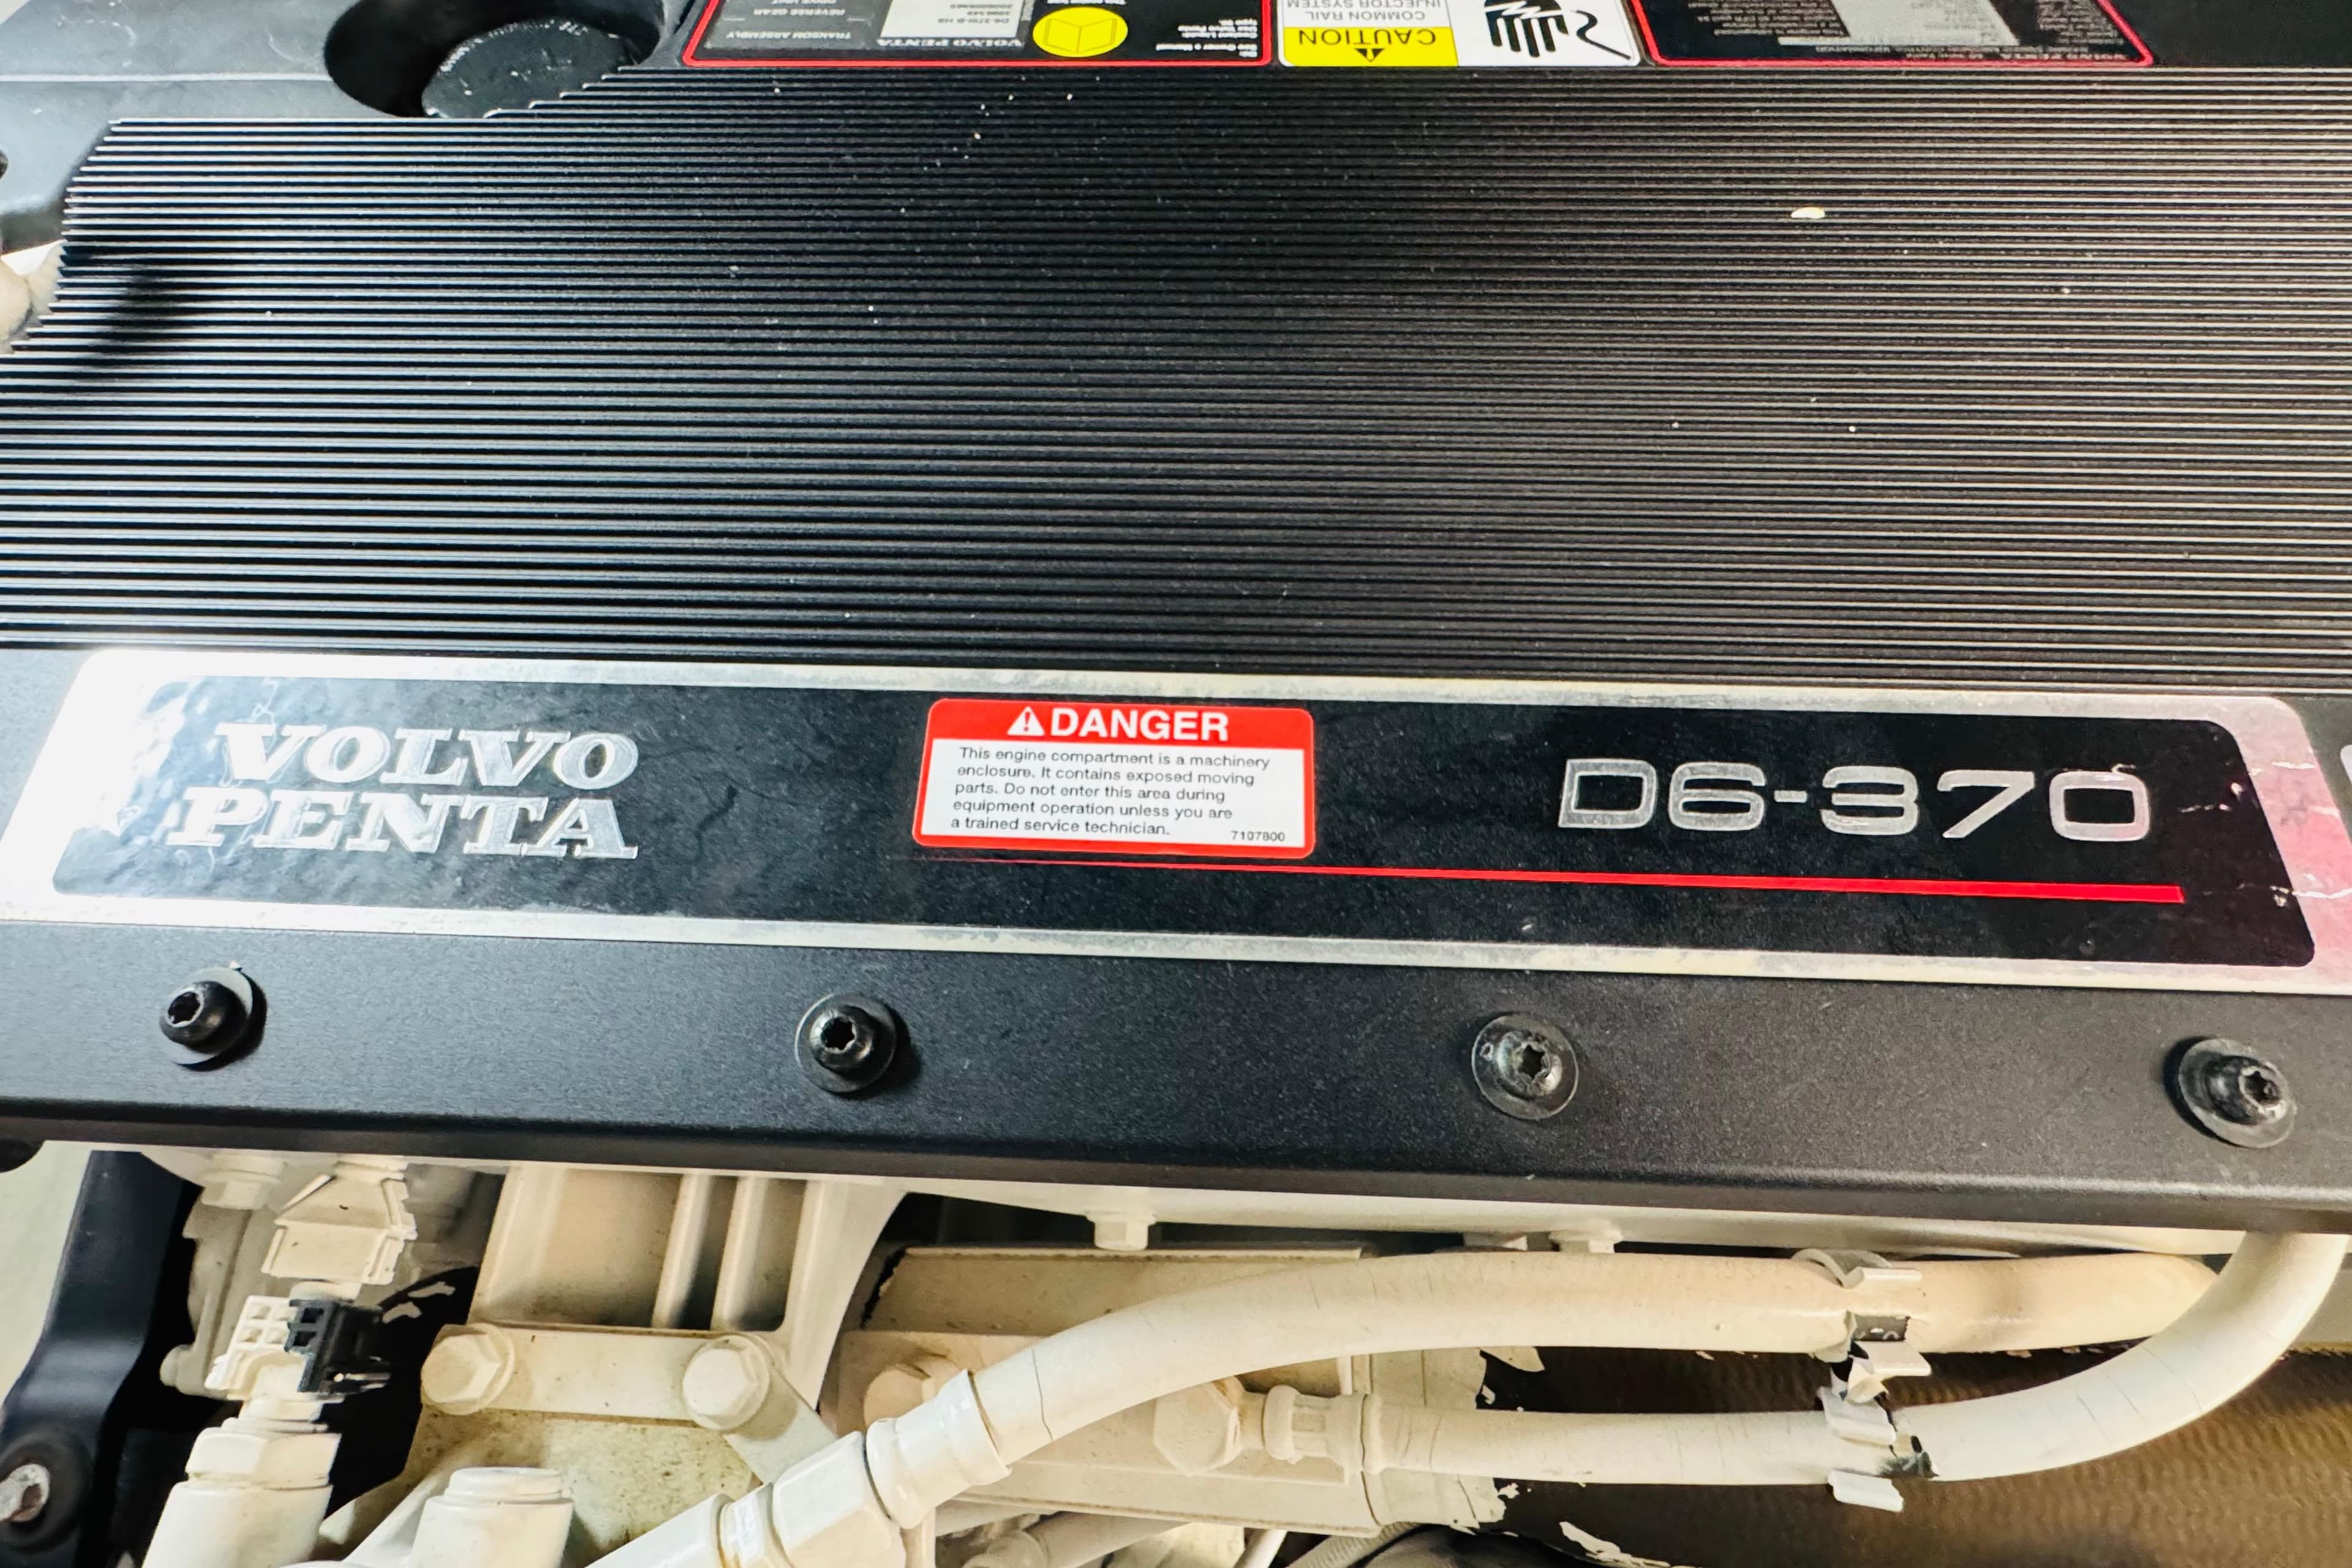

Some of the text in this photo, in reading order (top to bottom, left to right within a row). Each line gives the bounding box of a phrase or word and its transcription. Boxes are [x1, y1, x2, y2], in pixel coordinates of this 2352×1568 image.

[1305, 10, 1426, 20] COMMON RAIL
[1298, 29, 1436, 45] CAUTION
[1051, 707, 1229, 741] DANGER
[214, 722, 639, 790] VOLVO
[960, 747, 1269, 771] This engine compartment is a machinery
[957, 765, 1254, 786] enclosure. It contains exposed moving
[955, 783, 1225, 803] parts. Do not enter this area during
[1558, 758, 2150, 842] D6-370
[953, 801, 1232, 821] equipment operation unless you are
[167, 787, 638, 859] PENTA
[951, 816, 1170, 835] a trained service technician.
[1231, 831, 1286, 842] 7107800
